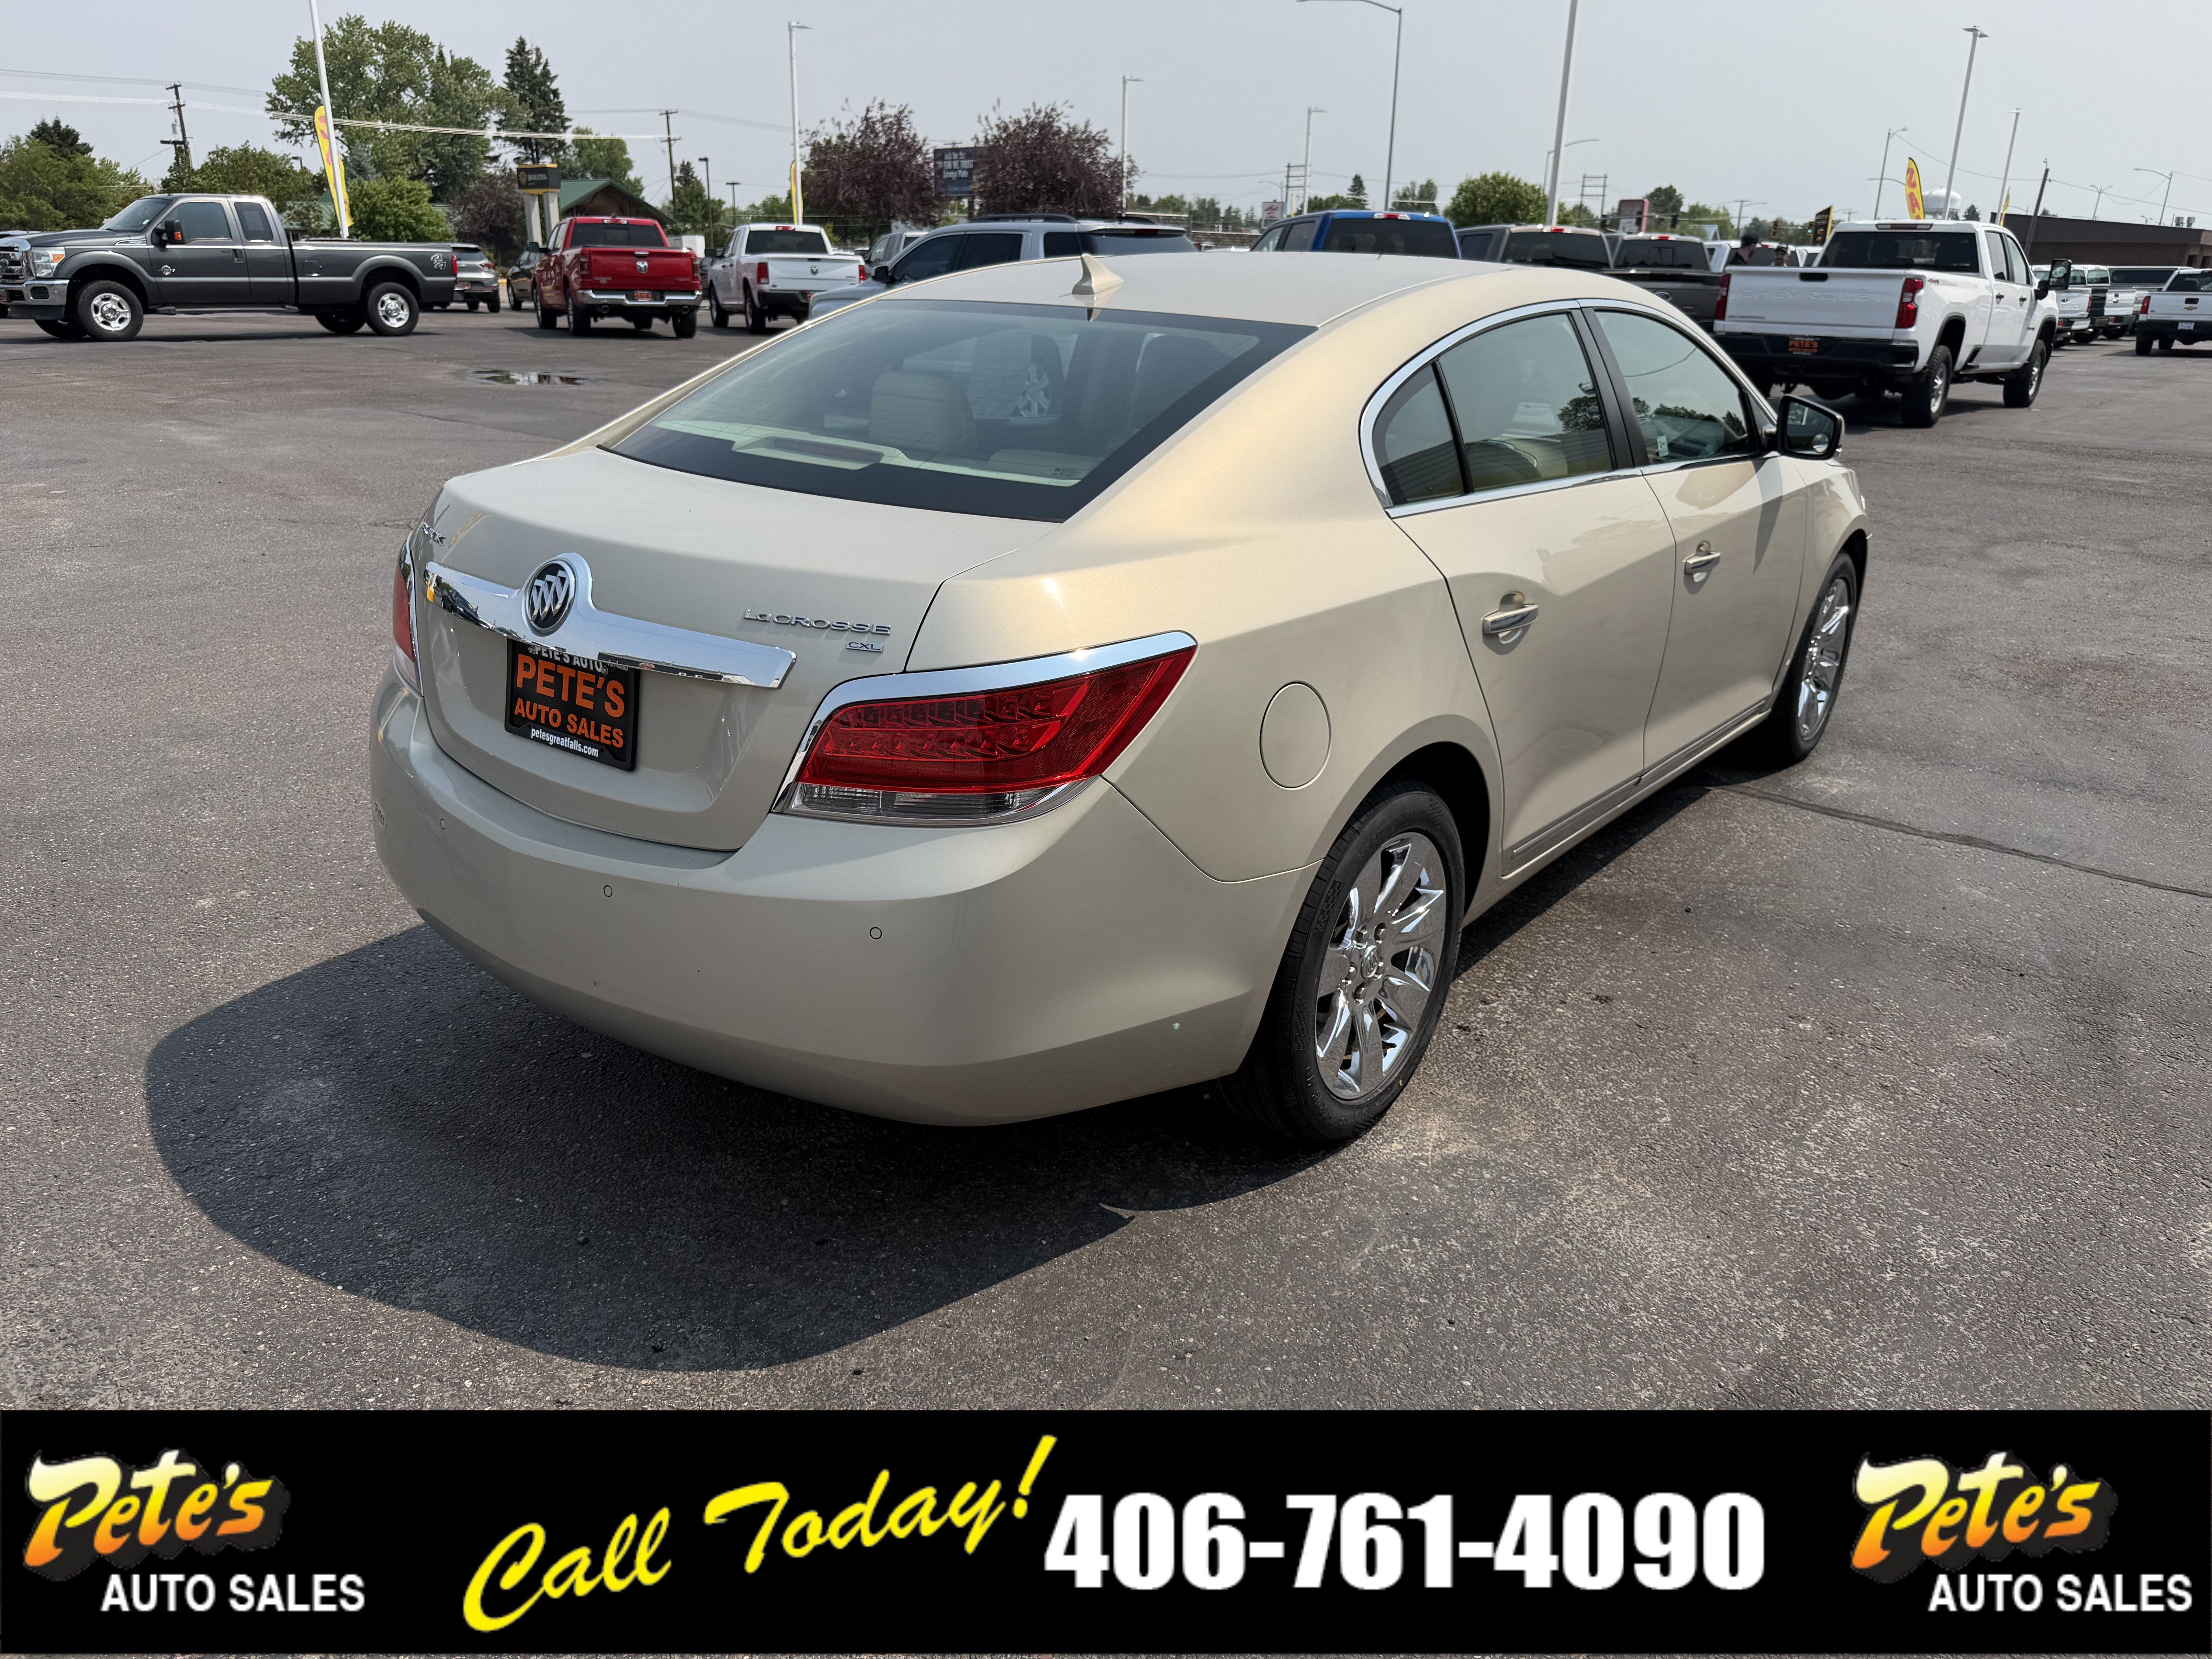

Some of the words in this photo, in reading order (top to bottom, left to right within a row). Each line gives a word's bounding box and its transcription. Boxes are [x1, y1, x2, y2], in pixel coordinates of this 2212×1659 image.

[1789, 340, 1819, 348] PETE'S
[848, 641, 882, 651] CXL
[517, 654, 625, 718] PETE'S
[514, 698, 562, 728] AUTO
[567, 714, 623, 748] SALES
[531, 727, 599, 757] petesgreatfalls.com
